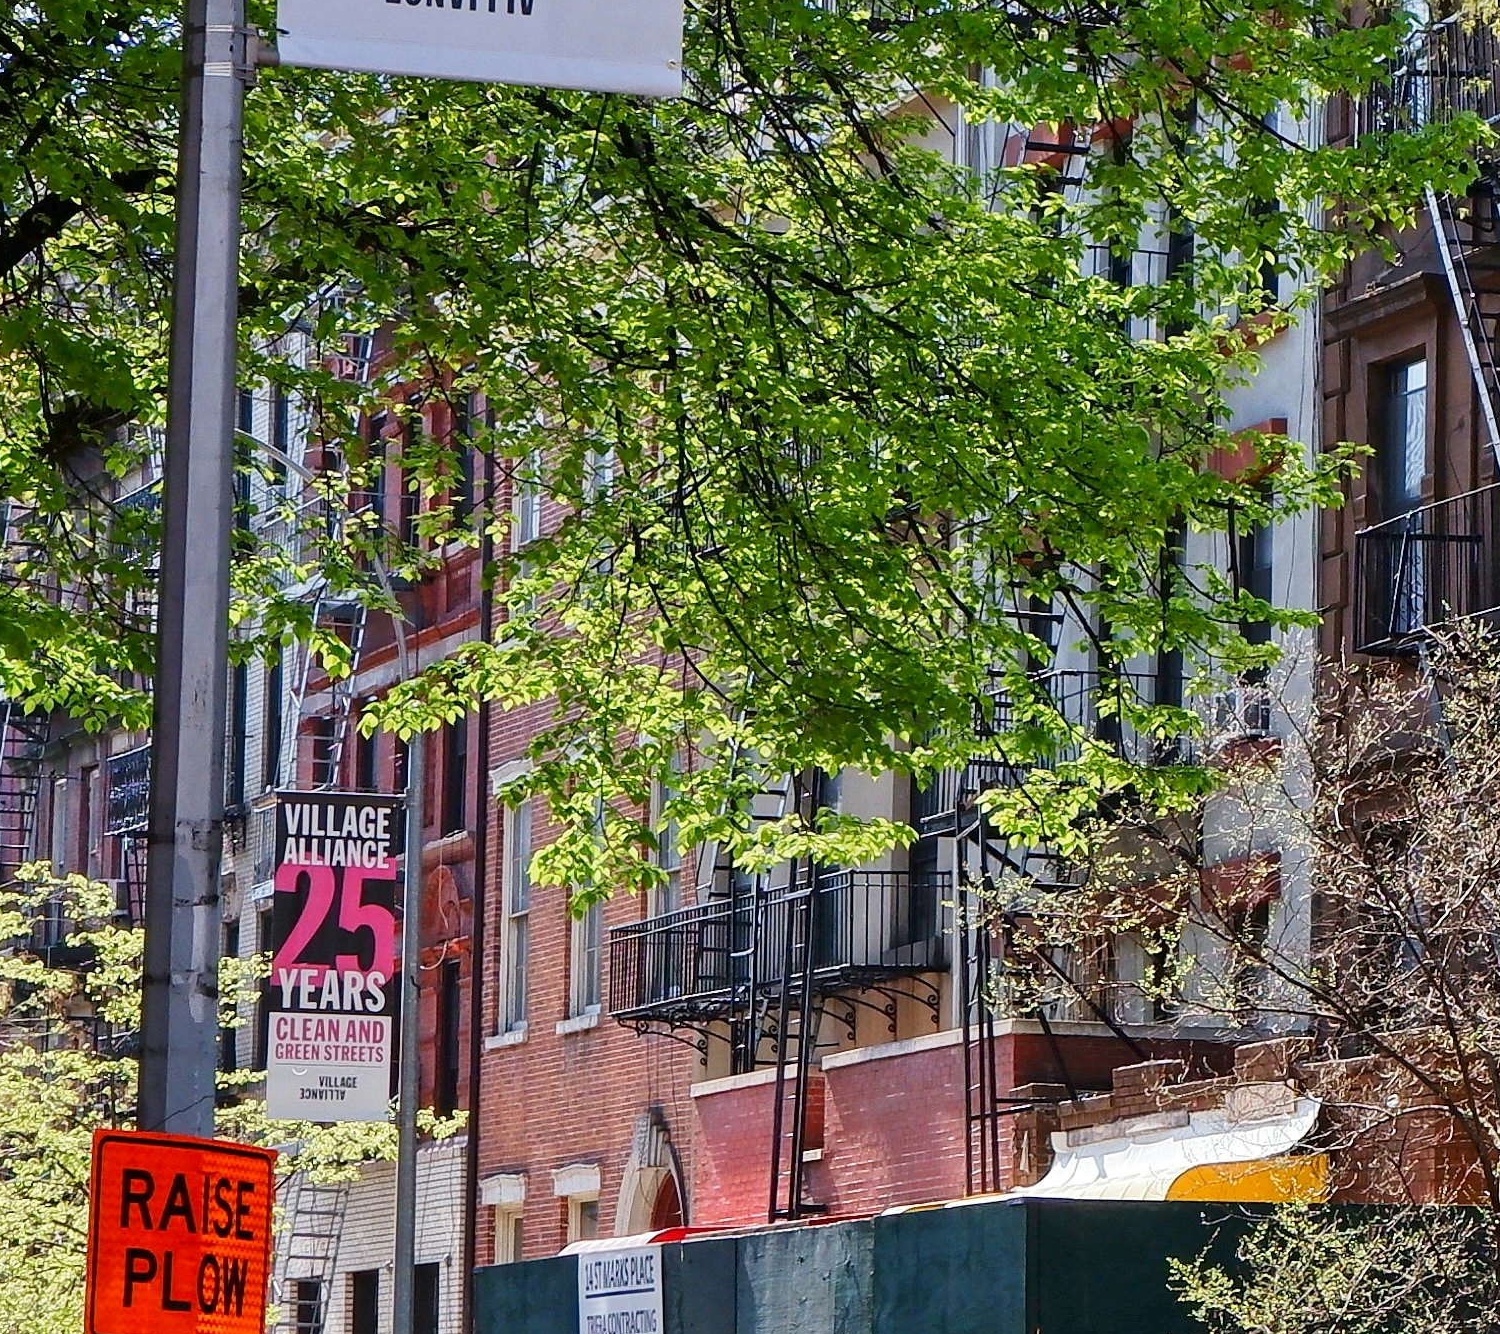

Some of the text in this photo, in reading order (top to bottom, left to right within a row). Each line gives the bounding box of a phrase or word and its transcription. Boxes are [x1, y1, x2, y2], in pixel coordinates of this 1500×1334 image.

[284, 803, 391, 839] VILLAGE
[283, 837, 390, 869] ALLIANCE
[270, 856, 397, 990] 25
[278, 967, 386, 1013] YEARS
[275, 1016, 385, 1044] CLEAN AND
[275, 1042, 384, 1063] GREEN STREETS
[318, 1075, 358, 1089] VILLAGE
[120, 1168, 256, 1241] RAISE
[122, 1248, 250, 1319] PLOW
[630, 1255, 655, 1285] PLACE
